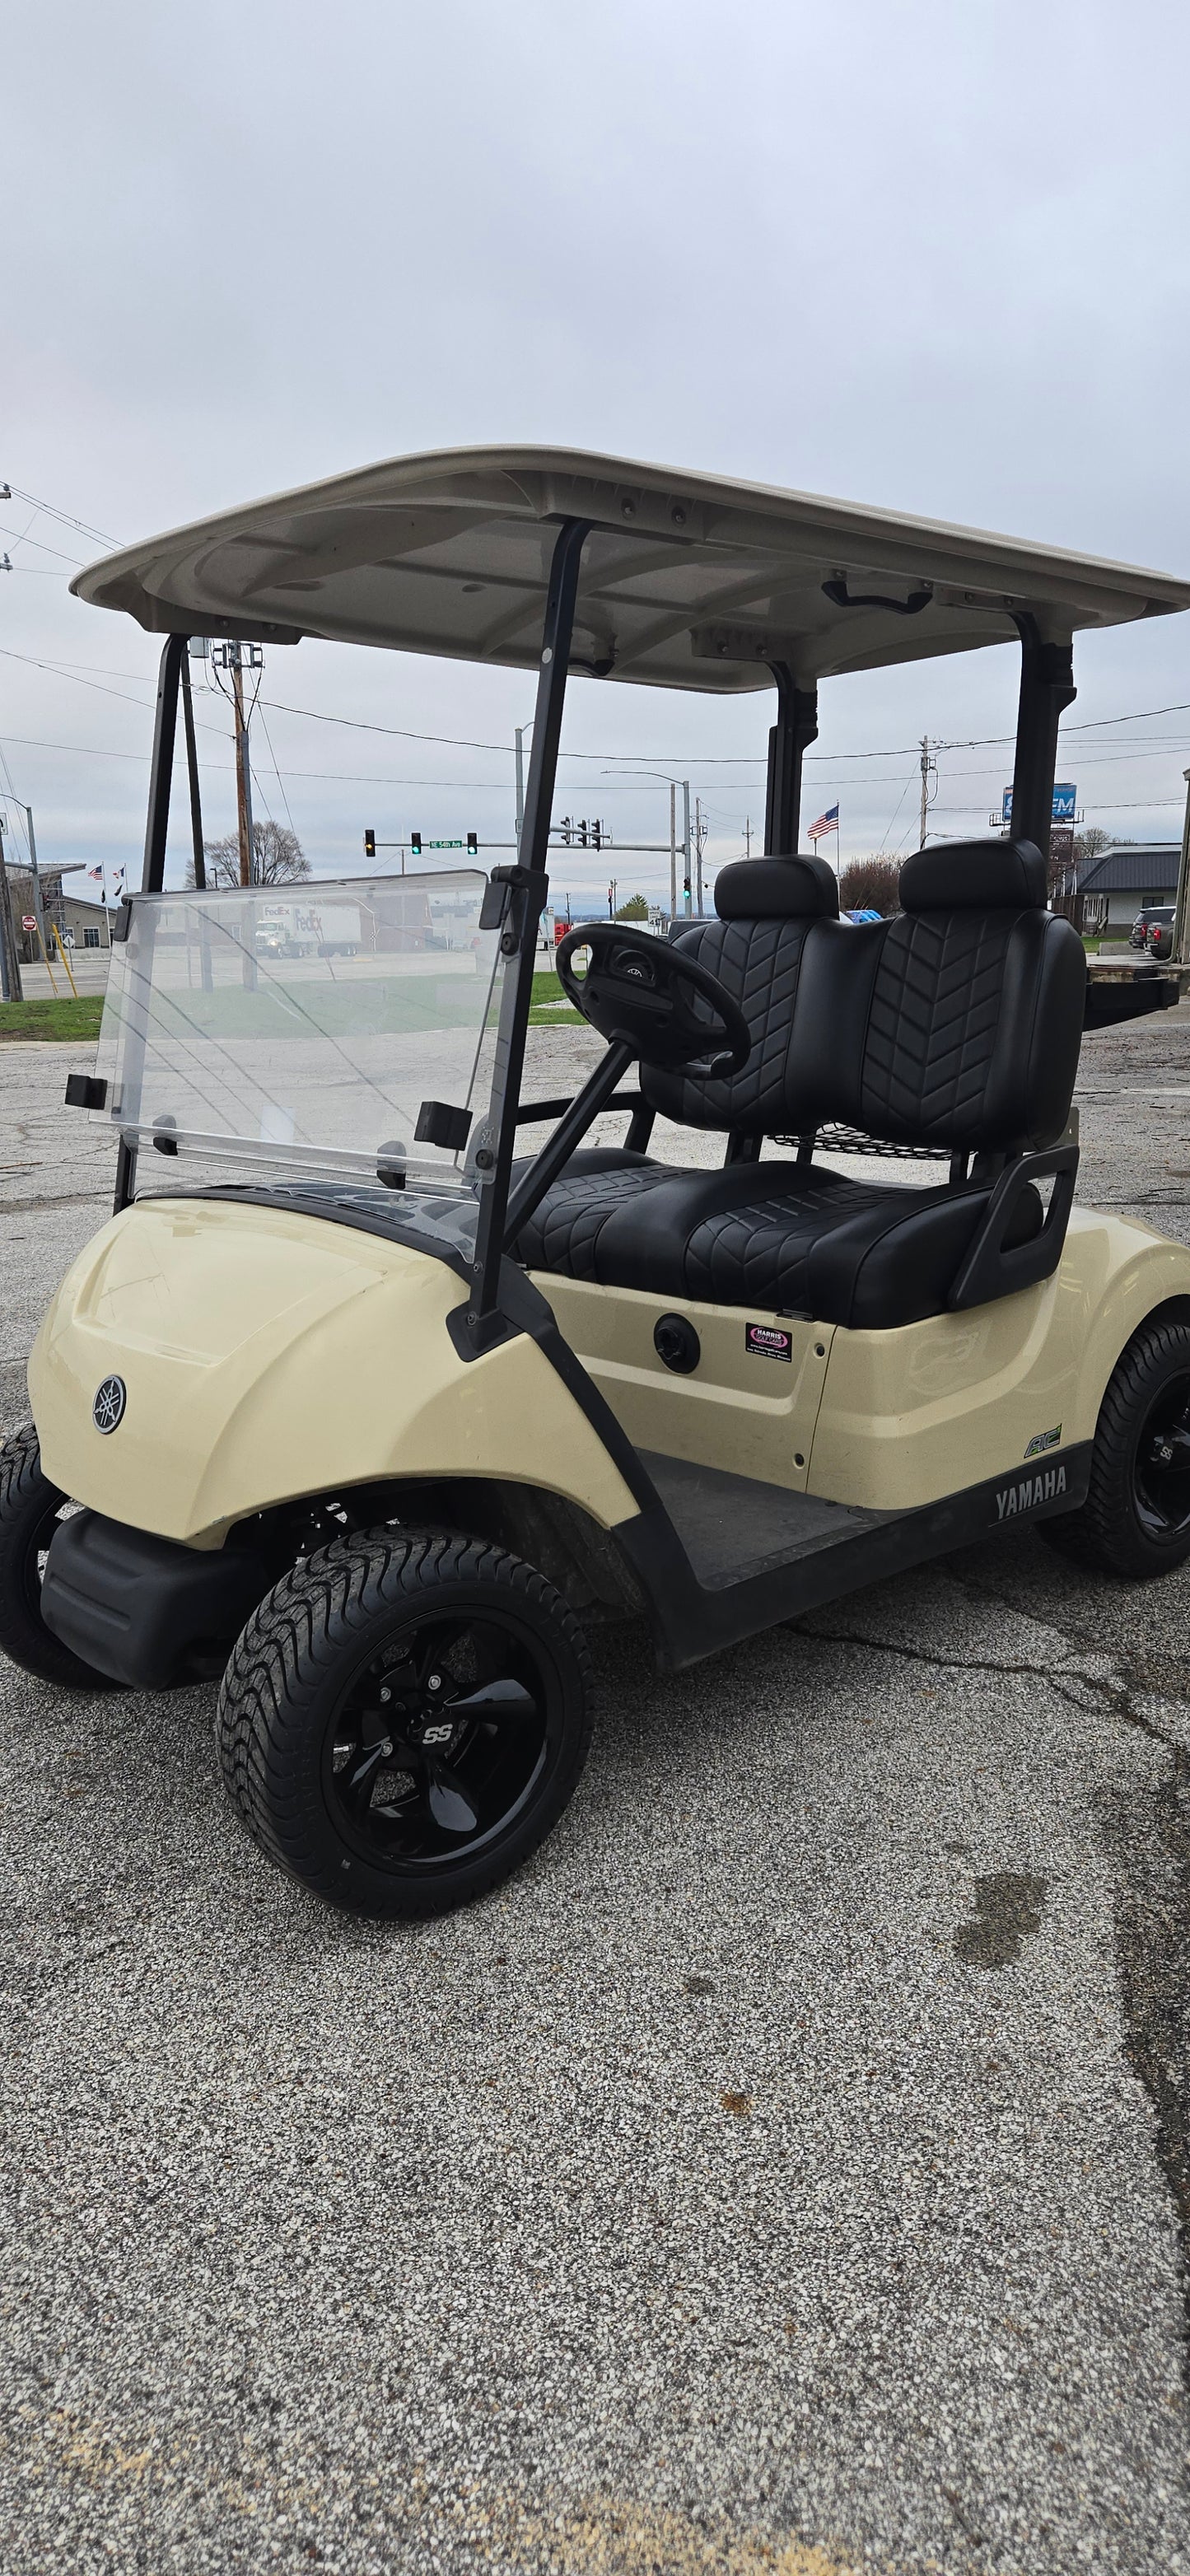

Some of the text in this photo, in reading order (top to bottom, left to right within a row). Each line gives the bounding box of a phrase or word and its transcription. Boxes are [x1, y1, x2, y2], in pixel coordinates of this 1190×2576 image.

[265, 907, 290, 916] FedEx
[295, 908, 322, 932] FedEx
[758, 1329, 782, 1340] HARRIS
[1024, 1428, 1061, 1458] AC
[1160, 1446, 1173, 1460] SS
[996, 1466, 1066, 1519] YAMAHA
[422, 1724, 453, 1744] SS
